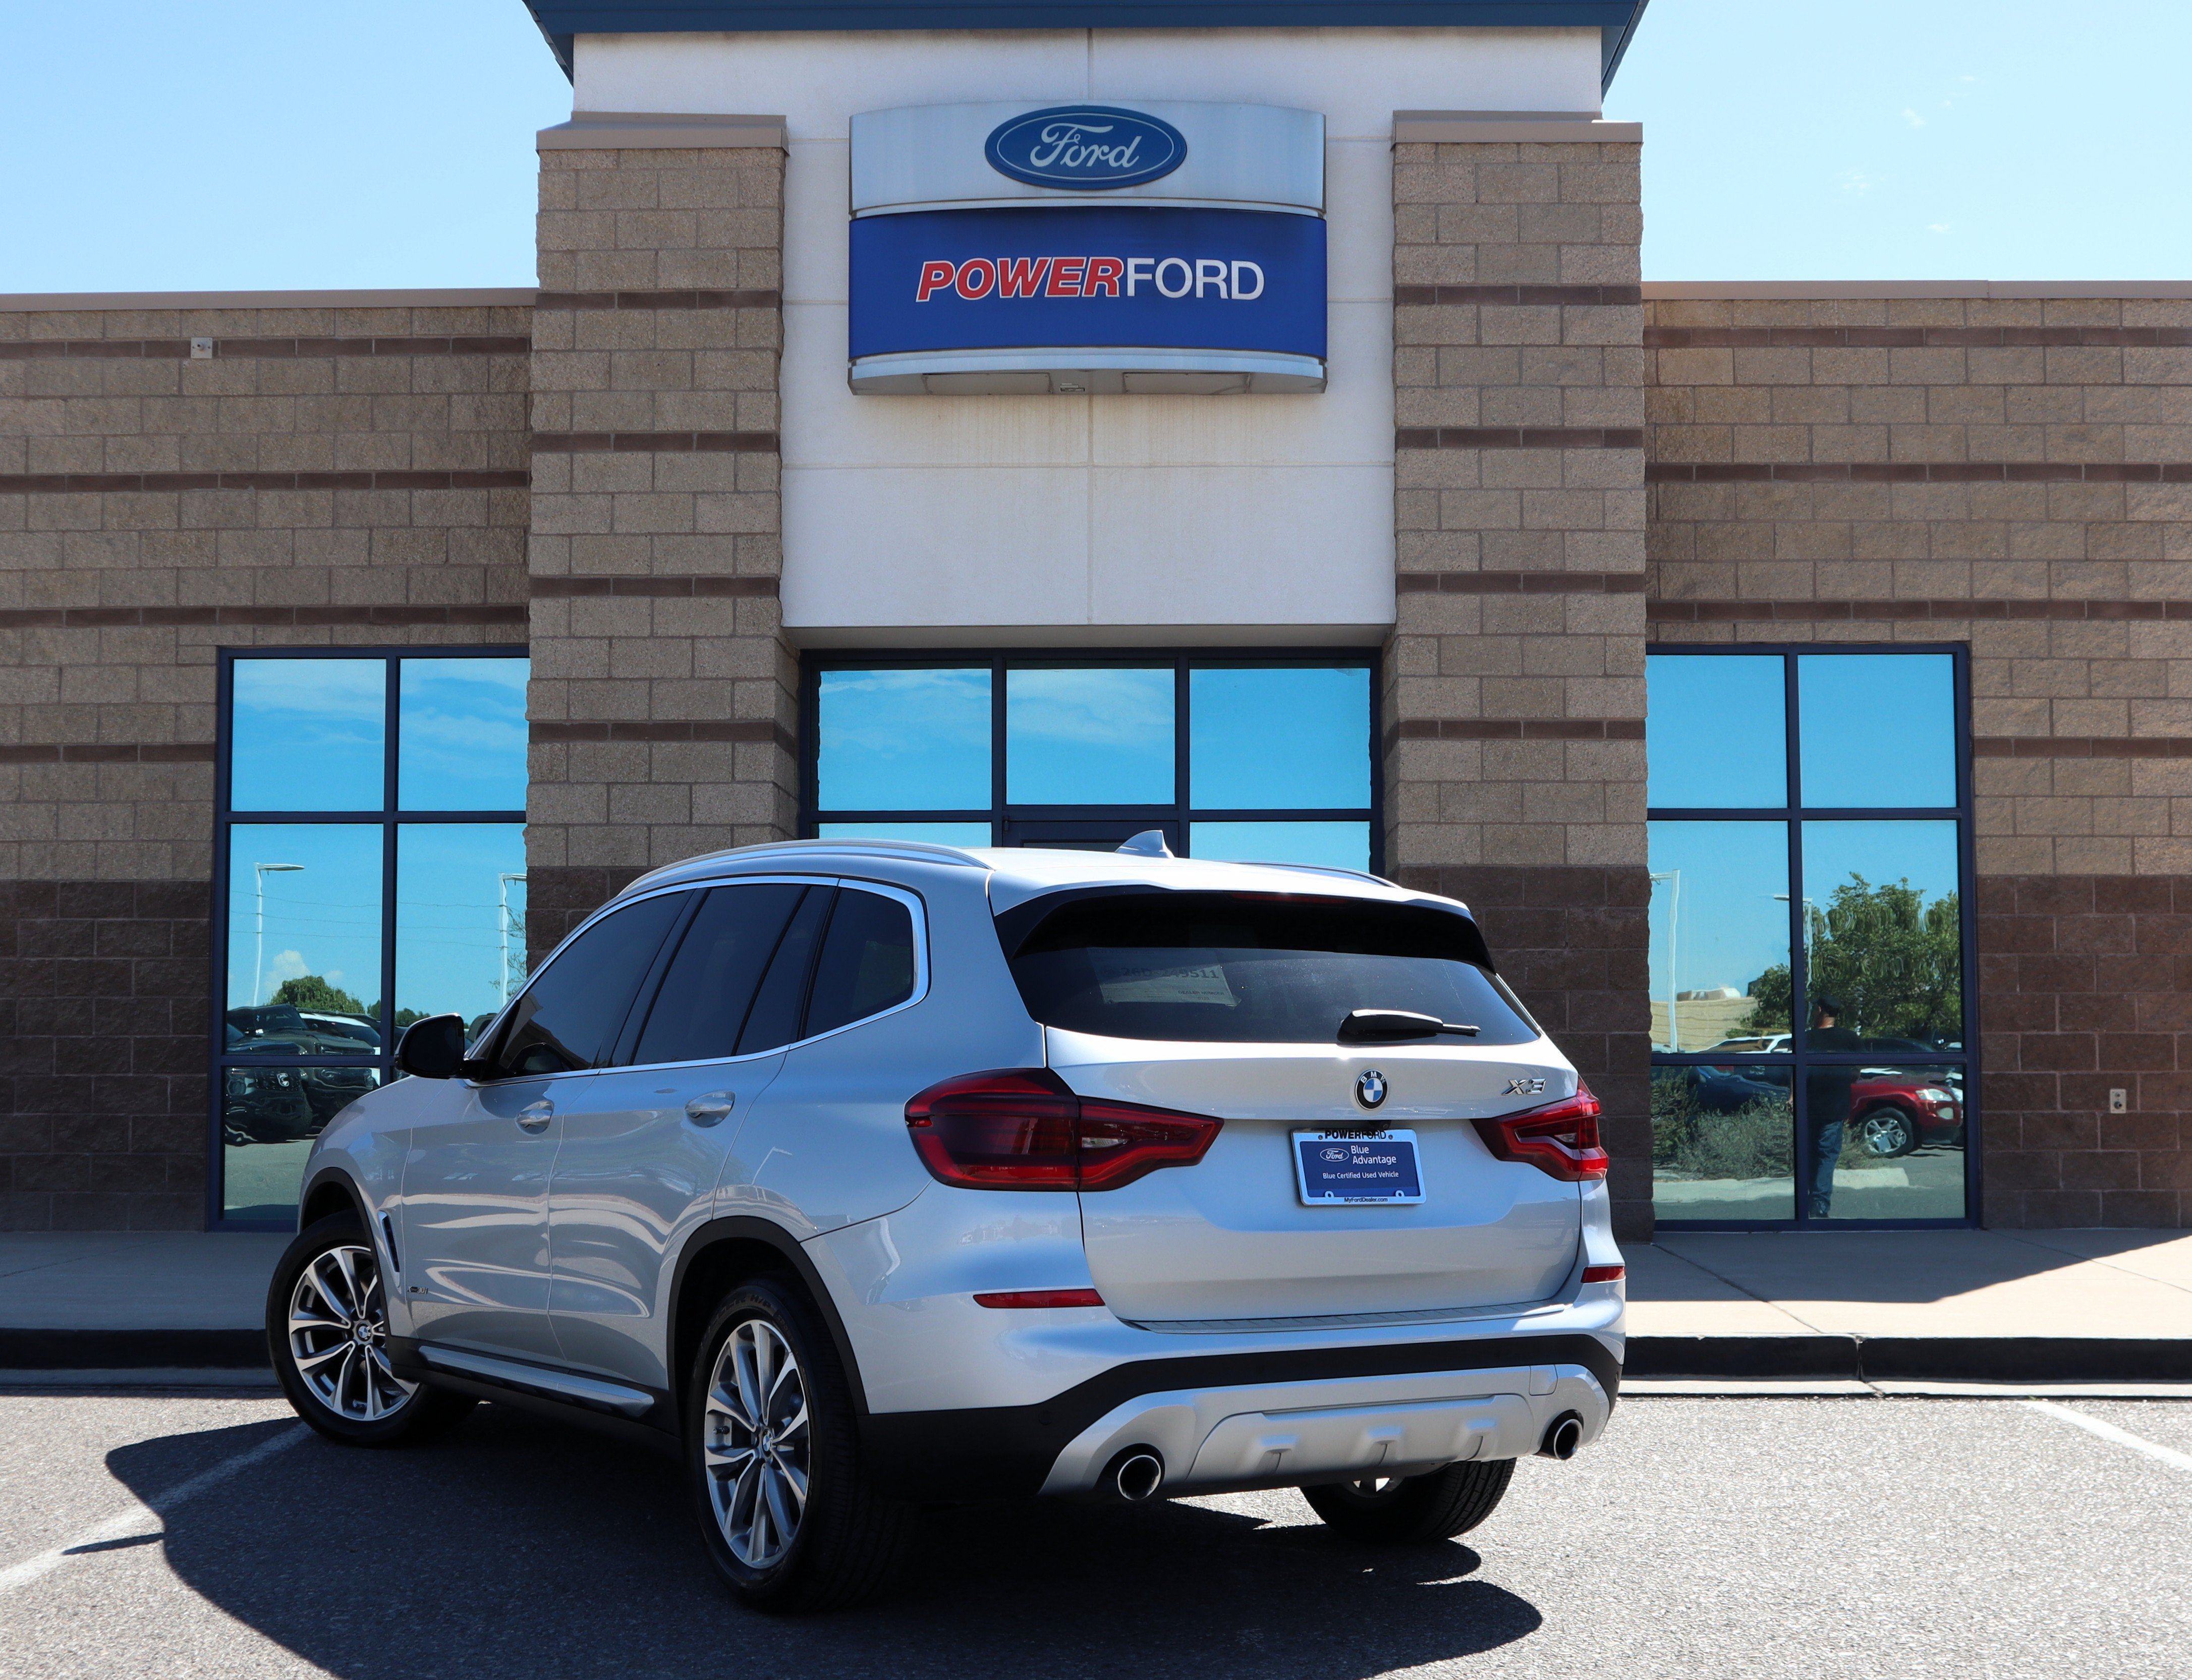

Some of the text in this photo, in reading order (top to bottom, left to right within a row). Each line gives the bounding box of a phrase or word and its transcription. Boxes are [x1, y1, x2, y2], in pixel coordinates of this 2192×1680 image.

[1030, 122, 1142, 168] Ford
[1361, 1071, 1386, 1084] BMW
[1501, 1079, 1546, 1096] X3
[1325, 1150, 1344, 1160] Ford
[1351, 1145, 1370, 1154] Blue
[1352, 1155, 1397, 1165] Advantage
